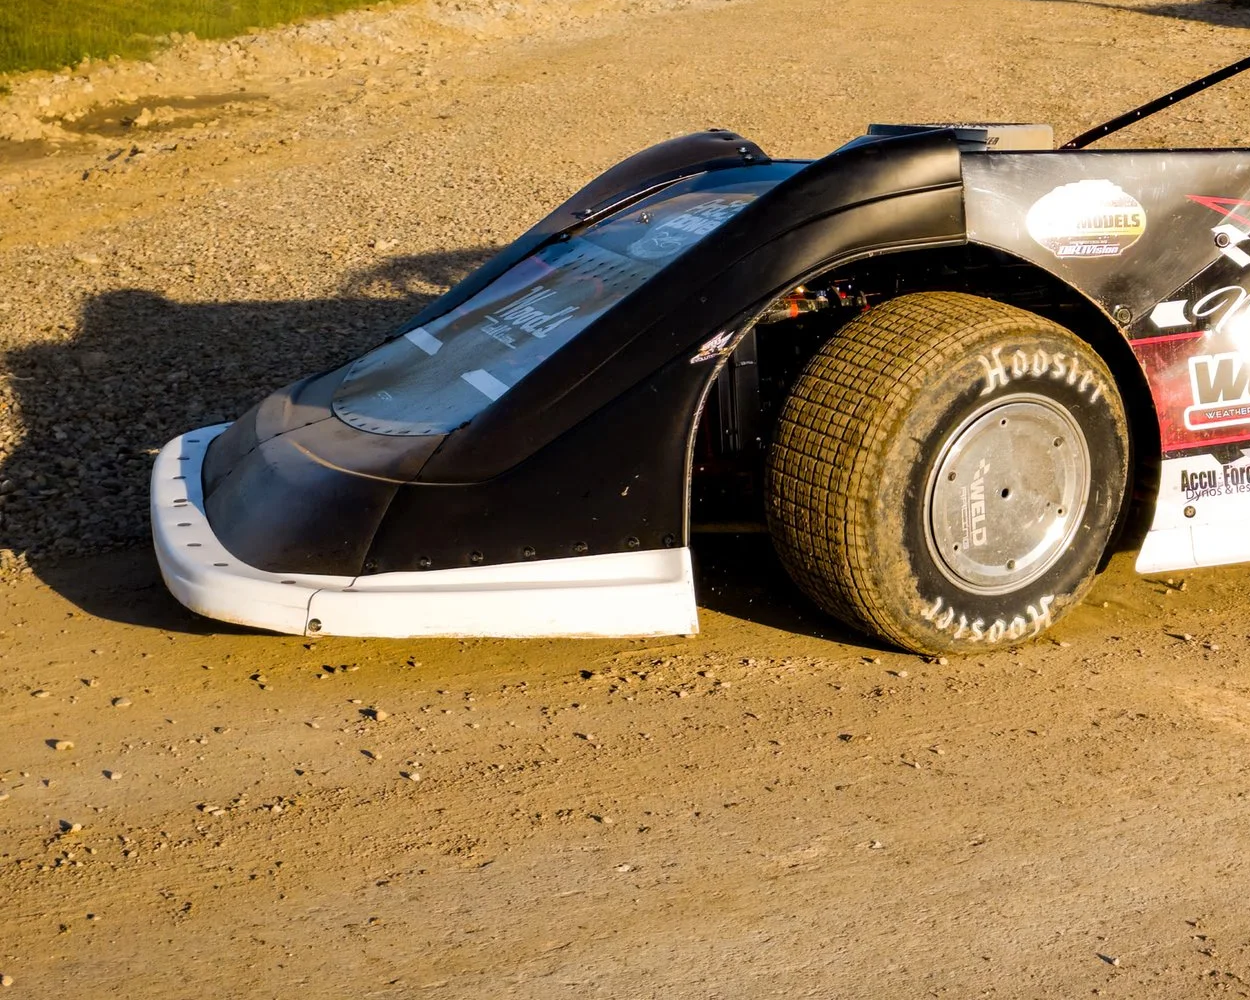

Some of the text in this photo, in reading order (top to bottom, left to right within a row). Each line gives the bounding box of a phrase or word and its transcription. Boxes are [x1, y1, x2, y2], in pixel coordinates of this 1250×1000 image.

[978, 347, 1106, 404] Hoosier
[1181, 470, 1217, 492] Accu
[1184, 488, 1222, 503] Dynos
[1225, 486, 1234, 494] &
[971, 477, 987, 546] WELD
[921, 594, 1054, 642] Hoosier
